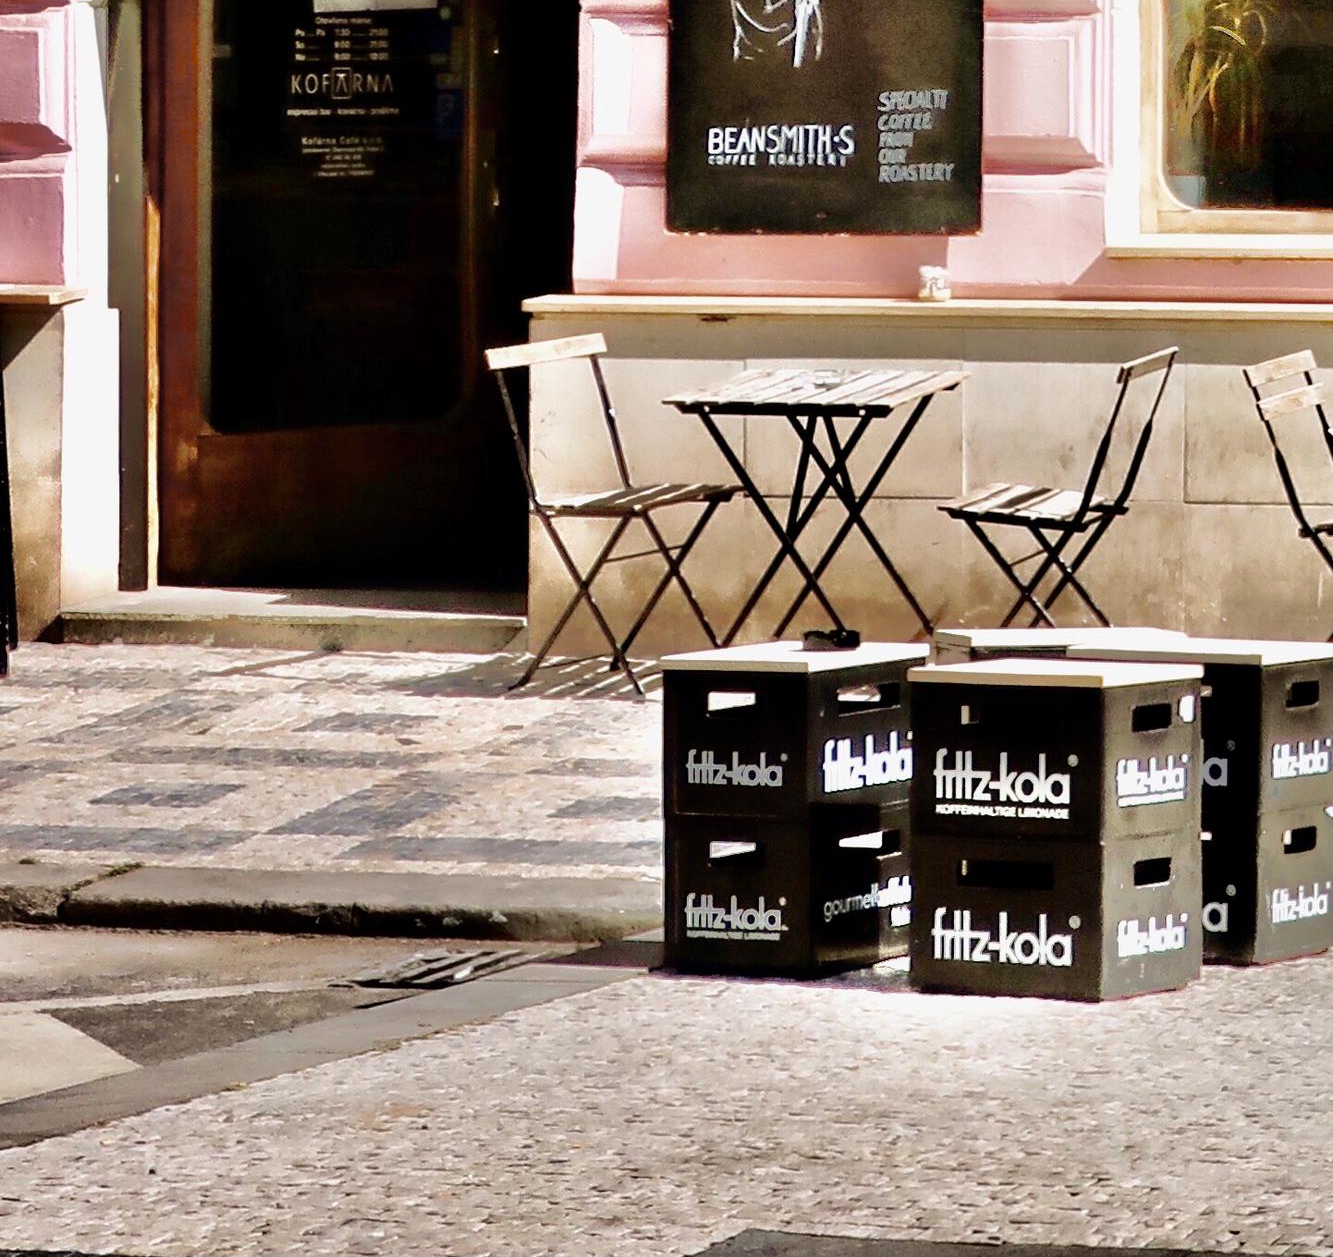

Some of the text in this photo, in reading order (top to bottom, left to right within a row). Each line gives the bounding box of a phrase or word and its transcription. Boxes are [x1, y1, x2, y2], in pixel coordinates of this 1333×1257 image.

[685, 749, 783, 787] fritz-kola
[933, 748, 1071, 804] fritz-kola
[685, 893, 783, 931] fritz-kola
[931, 907, 1073, 967] fritz-kola
